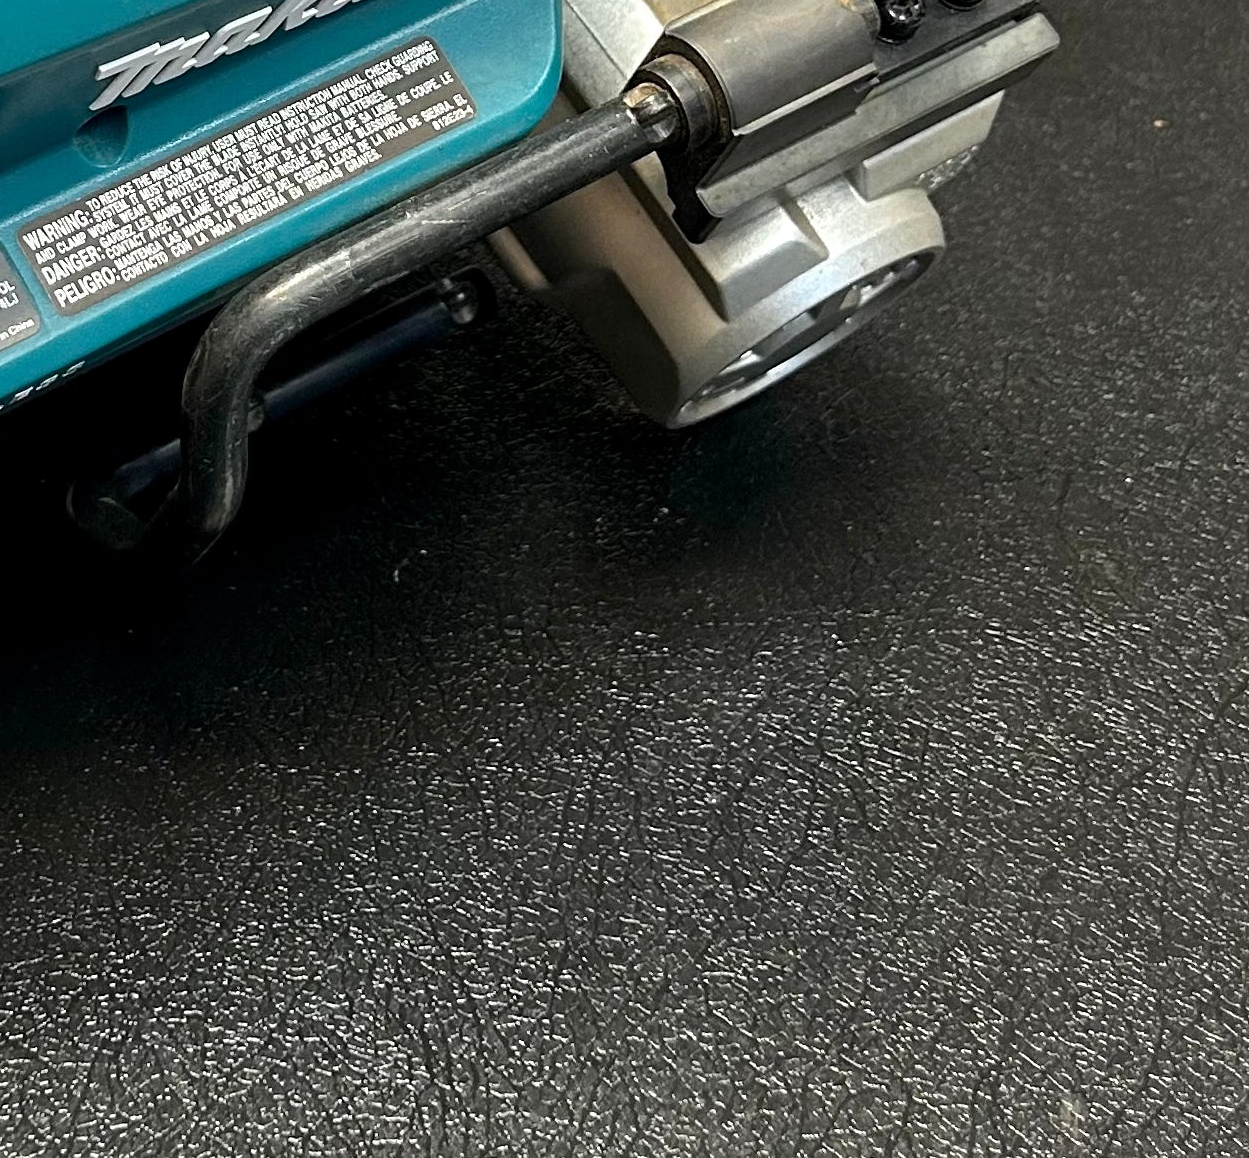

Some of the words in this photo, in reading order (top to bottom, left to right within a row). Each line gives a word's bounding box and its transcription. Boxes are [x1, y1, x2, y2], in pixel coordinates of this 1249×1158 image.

[22, 210, 93, 250] WARNING:
[85, 198, 101, 211] TO
[98, 182, 135, 206] REDUCE
[132, 174, 152, 189] THE
[149, 164, 172, 182] RISK
[170, 158, 182, 172] OF
[212, 134, 237, 152] USER
[234, 123, 258, 141] MUST
[256, 113, 281, 131] READ
[279, 88, 332, 120] INSTRUCTION
[365, 59, 394, 79] CHECK
[391, 41, 433, 66] GUARDING
[35, 247, 56, 264] AND
[56, 232, 86, 253] CLAMP
[118, 204, 147, 223] WEAR
[146, 193, 166, 211] EYE
[222, 158, 243, 174] FOR
[242, 148, 262, 164] USE
[262, 137, 285, 155] ONLY
[285, 126, 309, 143] WITH
[308, 111, 341, 133] MAKITA
[41, 245, 105, 285] DANGER:
[99, 224, 136, 248] GARDEZ
[134, 215, 154, 231] LES
[152, 202, 182, 222] MAINS
[180, 195, 194, 209] ET
[193, 189, 209, 203] LE
[208, 175, 238, 196] CORPS
[281, 147, 296, 161] DE
[294, 141, 309, 154] LA
[307, 129, 333, 148] LAME
[331, 123, 344, 136] ET
[344, 117, 359, 130] DE
[358, 111, 372, 124] SA
[370, 98, 398, 117] LIGNE
[396, 92, 411, 105] DE
[439, 71, 454, 85] LE
[54, 266, 120, 307] PELIGRO:
[114, 240, 163, 270] MANTENGA
[162, 231, 182, 247] LAS
[181, 215, 214, 238] MANOS
[213, 210, 222, 222] Y
[222, 202, 242, 218] LAS
[241, 185, 276, 208] PARTES
[274, 177, 294, 193] DEL
[293, 159, 329, 183] CUERPO
[329, 146, 357, 166] LEJOS
[356, 139, 371, 153] DE
[369, 133, 385, 146] LA
[383, 122, 408, 140] HOJA
[407, 115, 422, 129] DE
[453, 94, 467, 106] EL
[105, 232, 147, 259] CONTACT
[147, 220, 172, 240] AVEC
[172, 214, 188, 227] LA
[187, 200, 214, 220] LAME
[214, 177, 262, 207] COMPORTE
[261, 170, 277, 183] UN
[277, 153, 310, 176] RISQUE
[310, 146, 325, 160] DE
[325, 132, 356, 153] GRAVE
[129, 192, 139, 205] IT
[139, 181, 164, 200] MUST
[164, 167, 194, 188] COVER
[192, 158, 213, 174] THE
[210, 145, 241, 166] BLADE
[284, 113, 309, 131] HOLD
[308, 103, 328, 119] SAW
[327, 93, 350, 110] WITH
[348, 82, 373, 100] BOTH
[401, 50, 439, 74] SUPPORT
[121, 251, 168, 281] CONTACTO
[170, 239, 192, 257] CON
[193, 232, 209, 246] LA
[209, 219, 236, 238] HOJA
[288, 185, 304, 200] EN
[304, 166, 343, 191] HERIDAS
[8, 319, 34, 335] China
